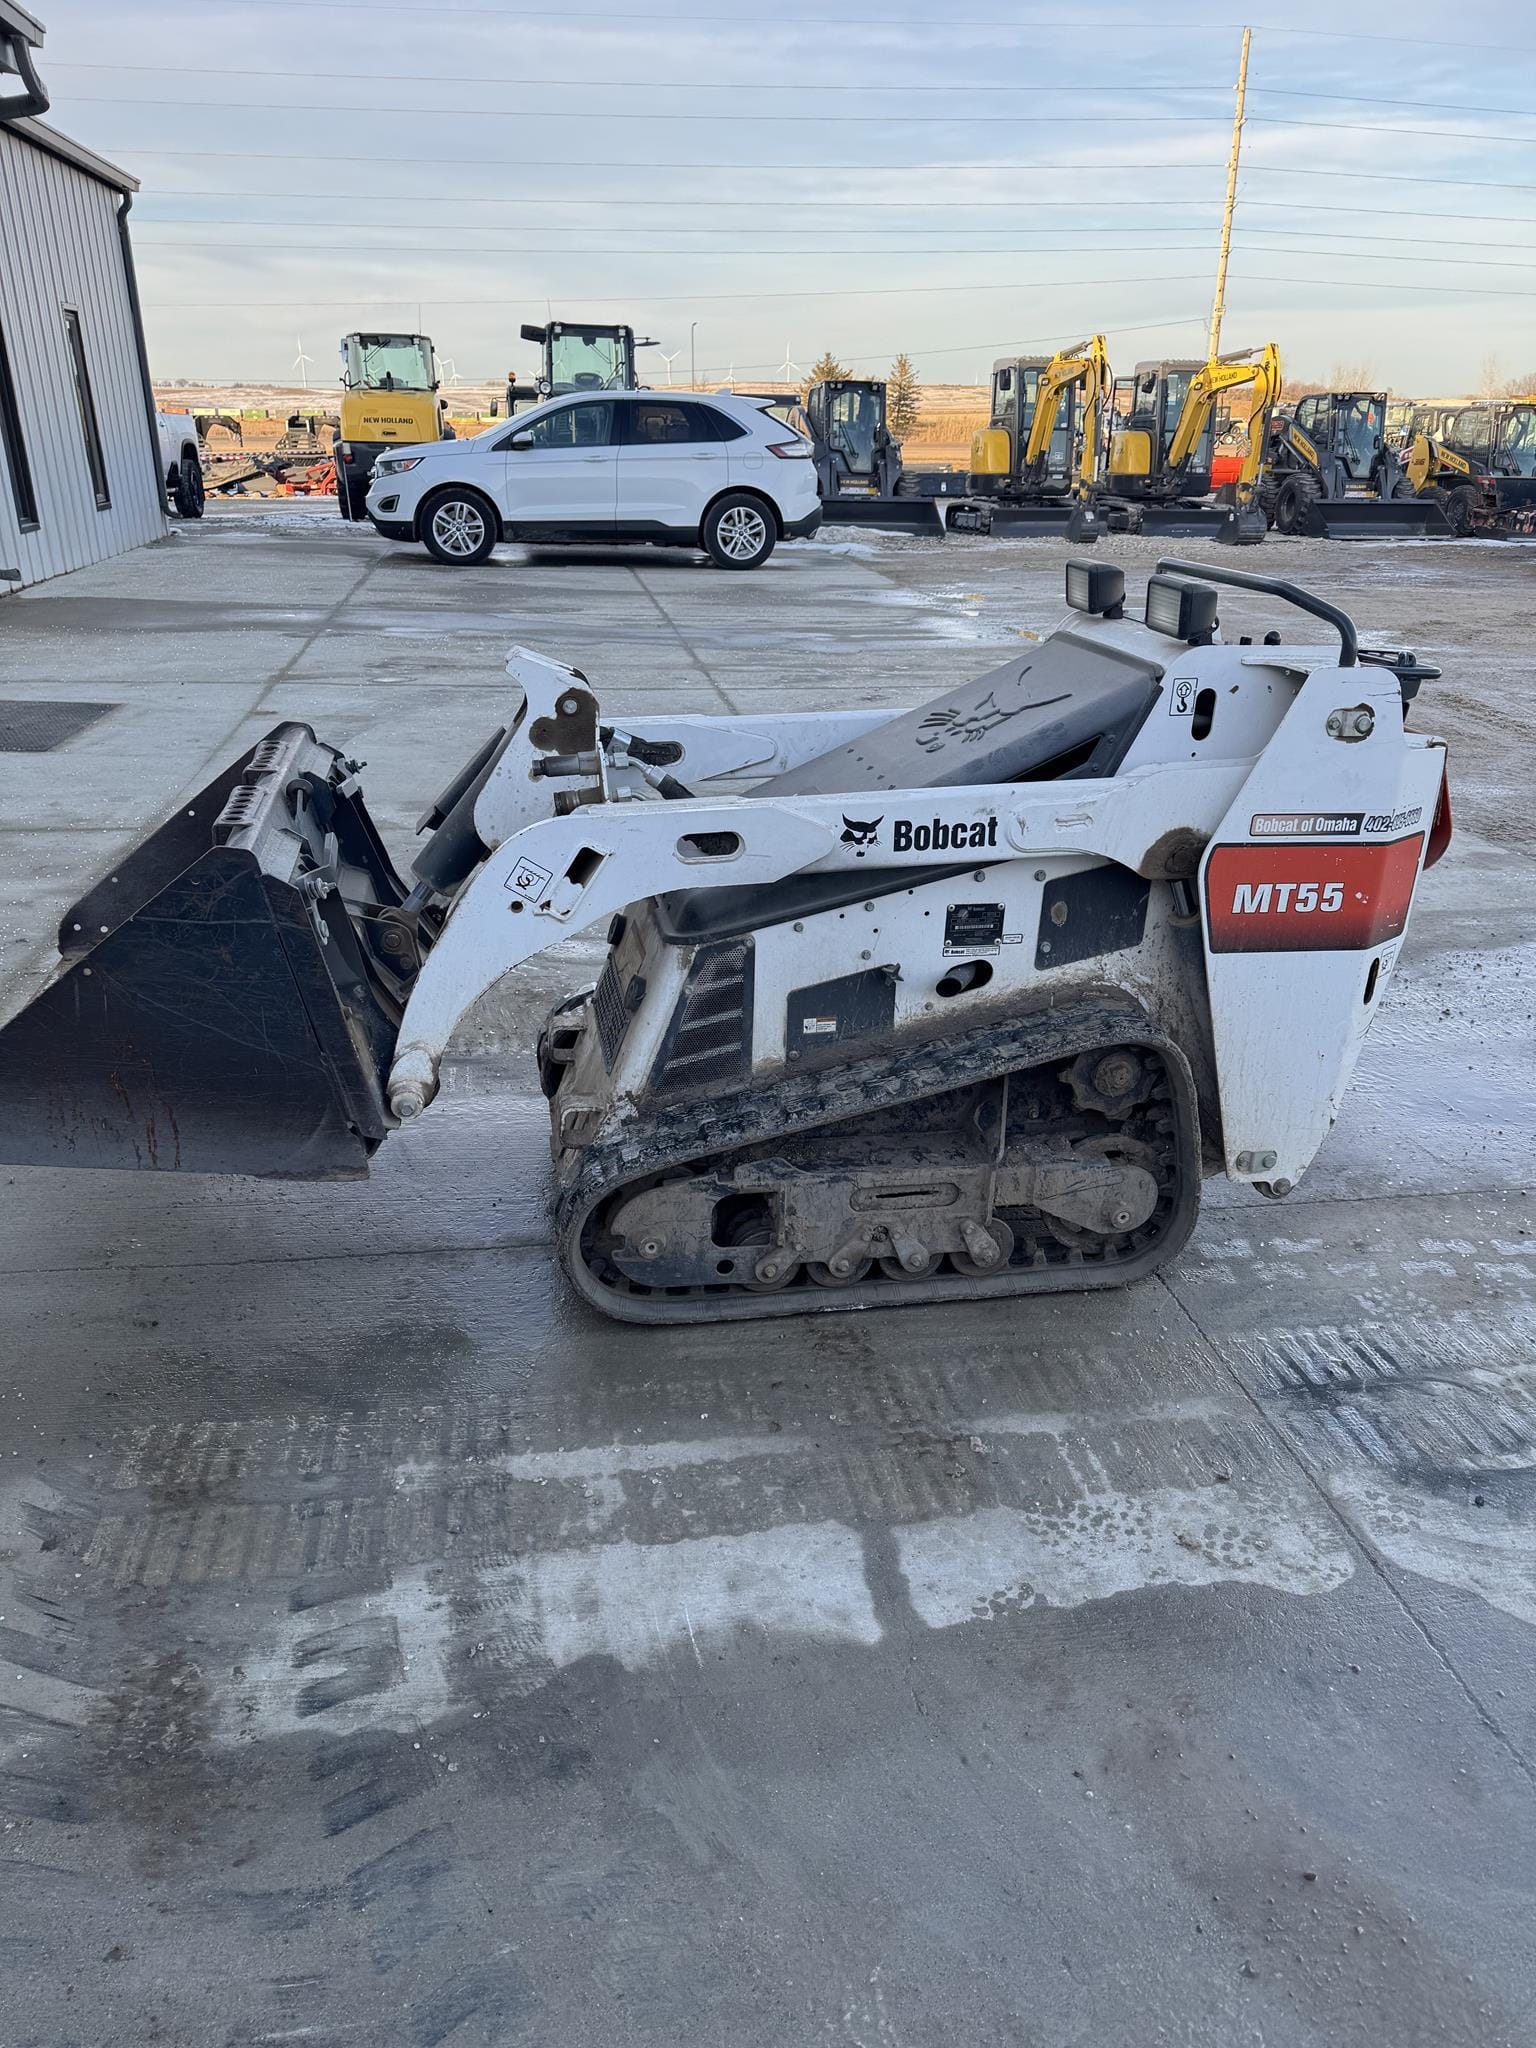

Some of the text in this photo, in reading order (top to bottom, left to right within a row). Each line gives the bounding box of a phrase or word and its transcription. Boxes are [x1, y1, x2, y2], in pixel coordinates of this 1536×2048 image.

[363, 416, 414, 425] NEW HOLLAND
[893, 816, 998, 852] Bobcat
[1254, 817, 1298, 833] Bobcat
[1300, 817, 1314, 832] of
[1315, 816, 1358, 832] Omaha
[1232, 883, 1344, 914] MT55
